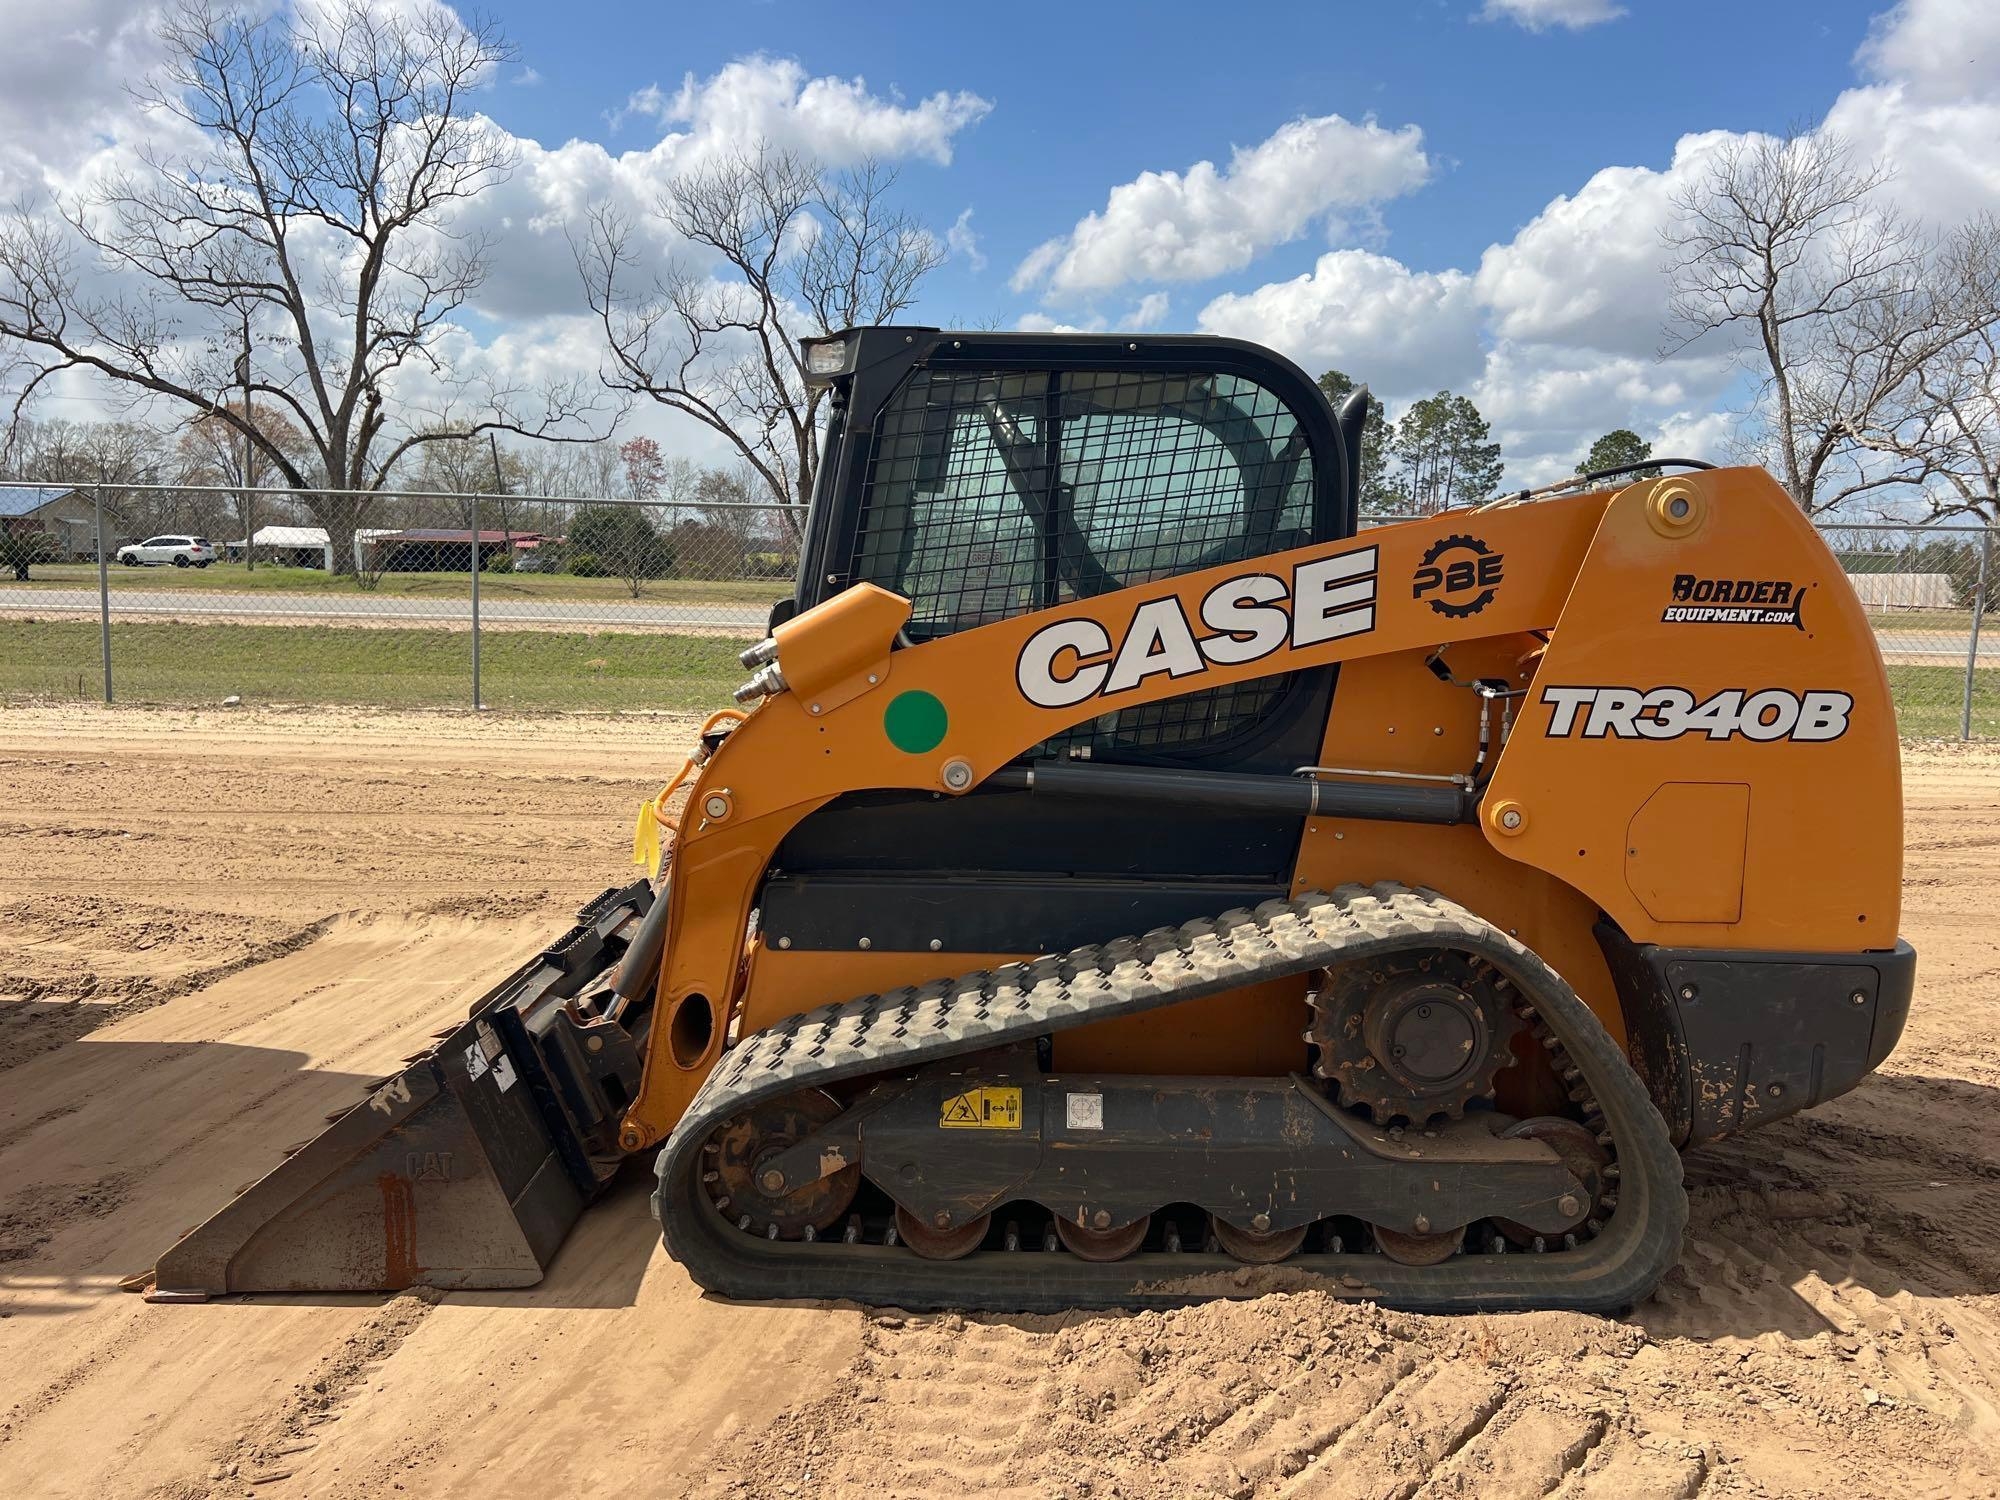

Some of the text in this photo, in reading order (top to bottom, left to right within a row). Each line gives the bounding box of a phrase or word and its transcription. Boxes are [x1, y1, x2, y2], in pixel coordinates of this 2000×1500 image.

[1413, 554, 1504, 599] PBE
[1673, 574, 1792, 603] BORDER
[1015, 545, 1378, 708] CASE
[1541, 685, 1854, 743] TR340B
[406, 1152, 455, 1183] CAT
